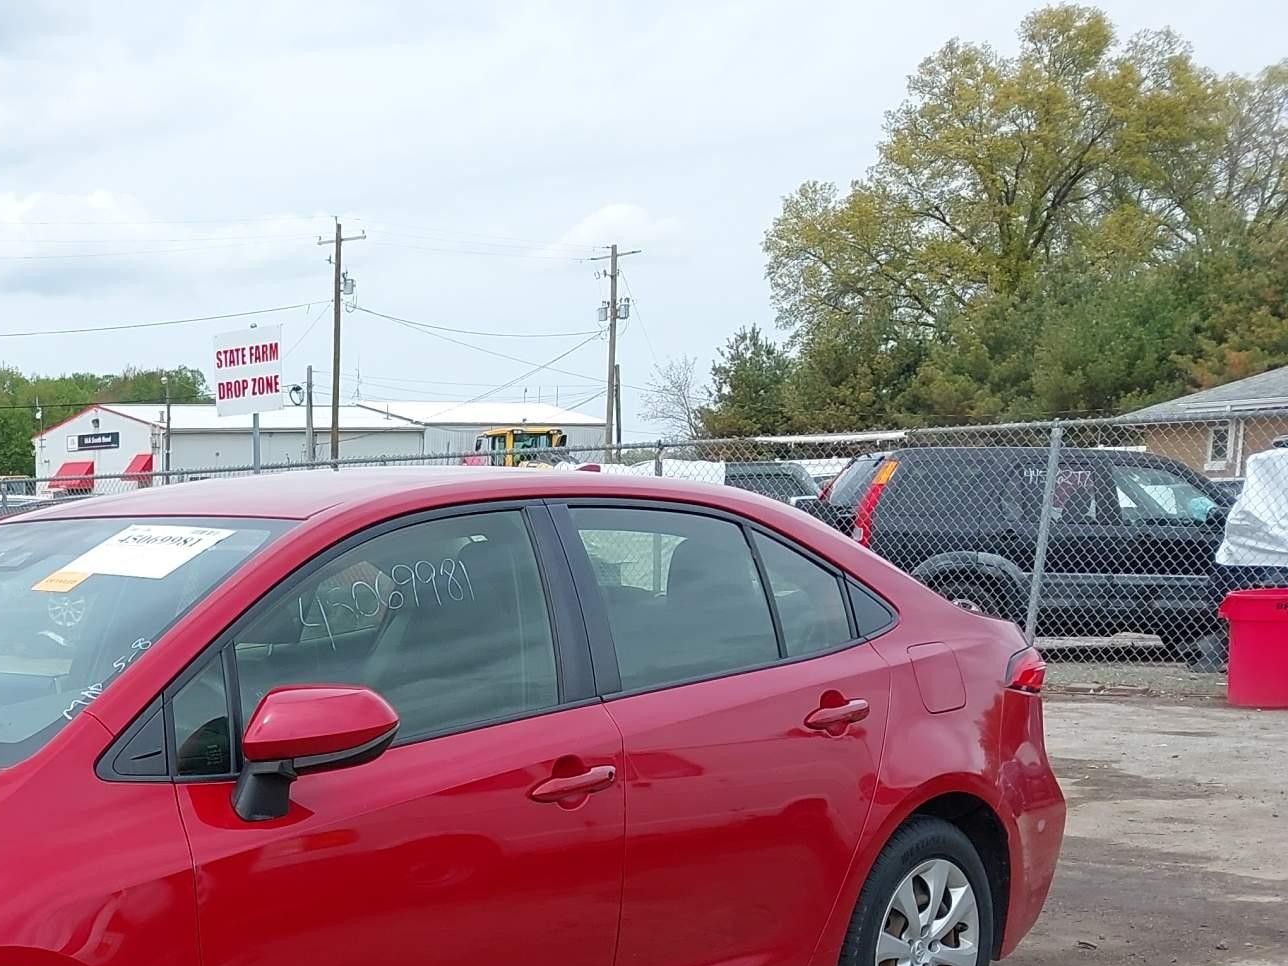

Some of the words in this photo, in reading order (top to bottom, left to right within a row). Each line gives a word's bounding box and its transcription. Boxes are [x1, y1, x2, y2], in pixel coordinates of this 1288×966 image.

[216, 347, 247, 369] STATE
[249, 342, 279, 364] FARM
[218, 379, 249, 400] DROP
[251, 374, 280, 396] ZONE
[299, 558, 474, 650] 45069981
